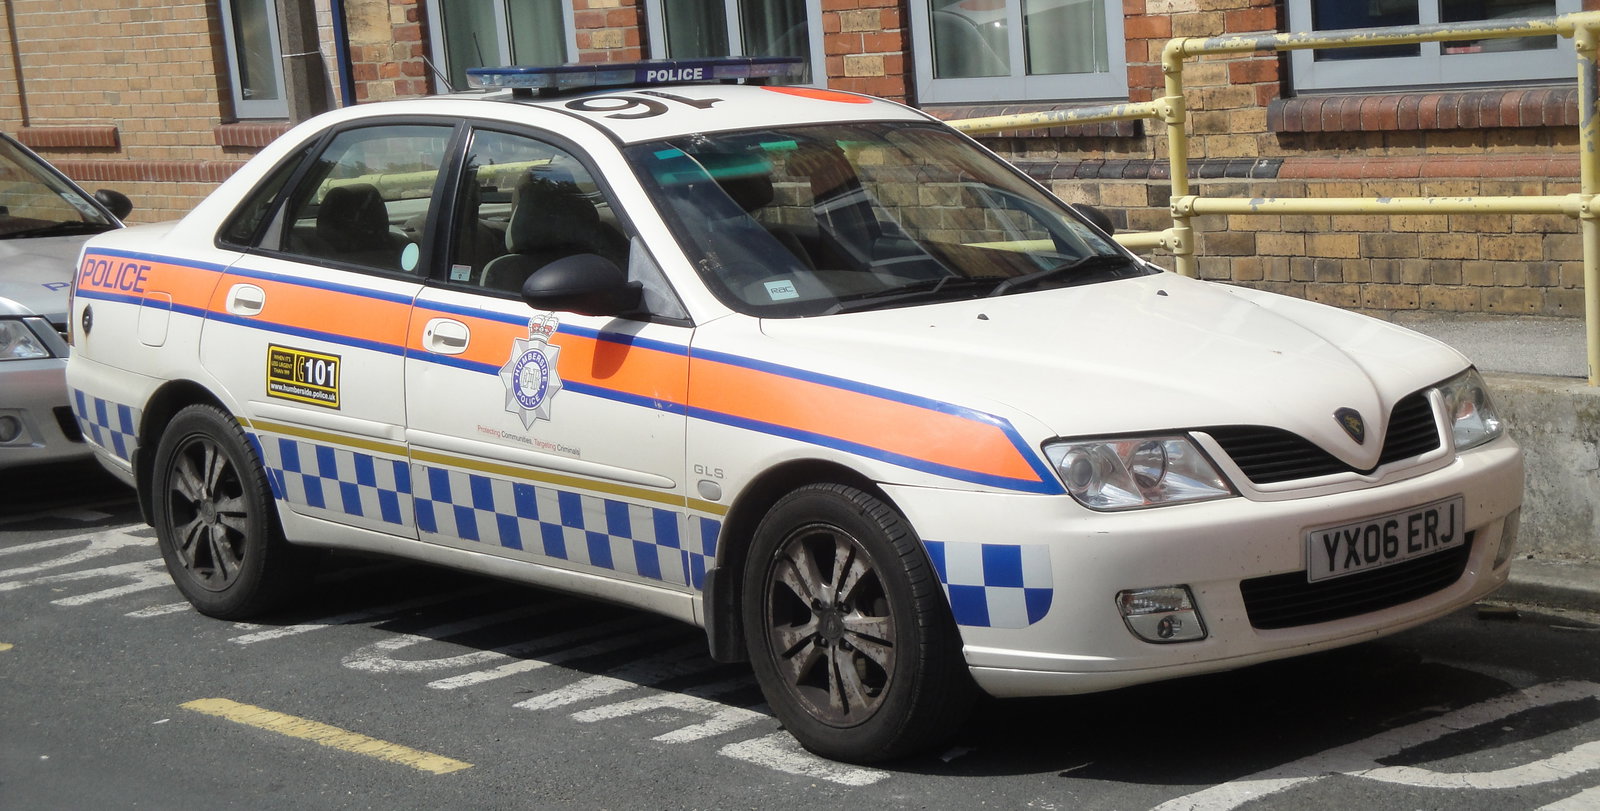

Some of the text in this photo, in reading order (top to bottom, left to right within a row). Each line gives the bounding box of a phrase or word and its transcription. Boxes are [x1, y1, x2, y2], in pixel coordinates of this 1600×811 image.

[646, 67, 703, 82] POLICE
[81, 258, 151, 293] POLICE
[305, 358, 335, 387] 101
[514, 352, 548, 382] HUMBERSIDE
[270, 383, 336, 401] www.humberside.police.uk
[517, 390, 541, 406] POLICE
[477, 424, 501, 438] Protecting
[533, 438, 556, 451] Targeting
[556, 443, 580, 456] Criminals
[694, 464, 724, 479] GLS
[1323, 503, 1455, 572] YX06 ERJ
